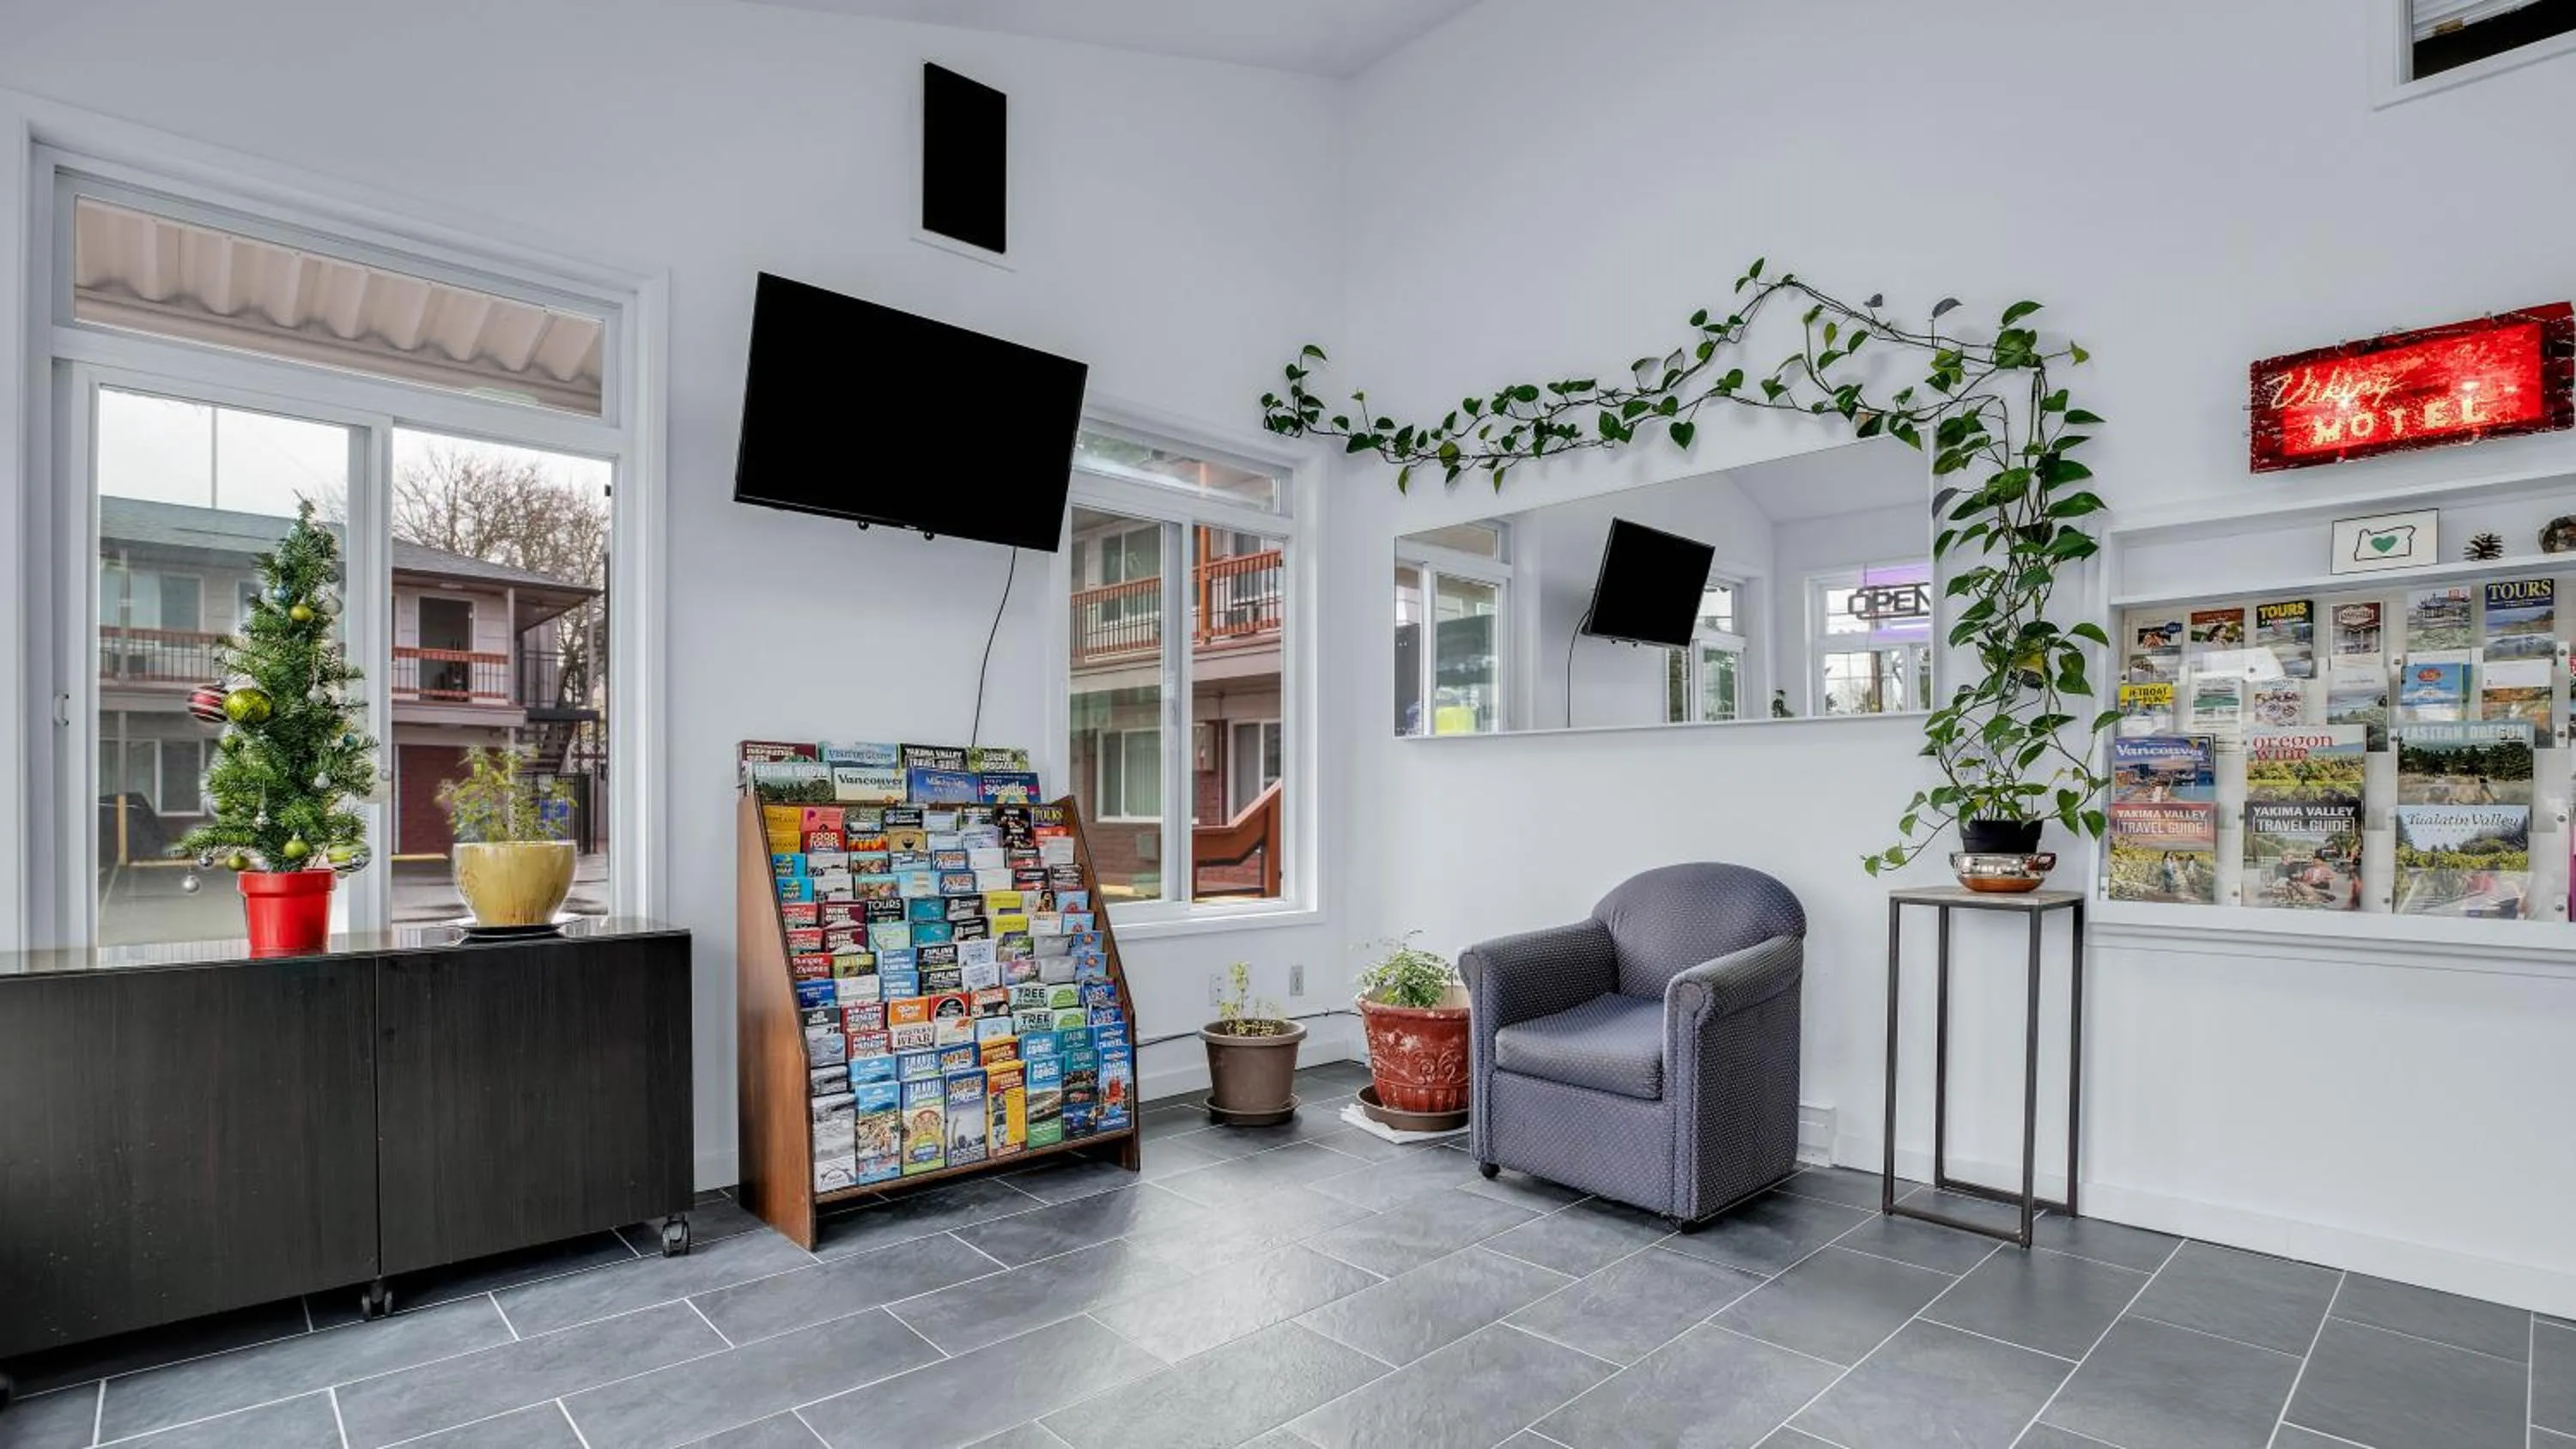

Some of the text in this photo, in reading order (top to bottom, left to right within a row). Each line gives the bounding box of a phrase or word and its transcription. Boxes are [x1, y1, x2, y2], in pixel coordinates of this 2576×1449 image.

[2267, 366, 2402, 410] Viking
[2312, 397, 2487, 445] MOTEL
[2488, 579, 2551, 600] TOURS
[2258, 602, 2306, 619] TOURS
[2403, 727, 2463, 740] EASTERN
[2252, 734, 2335, 751] oregon
[2117, 744, 2204, 756] Vancouver
[2255, 747, 2310, 761] wine
[837, 773, 903, 785] Vancouver
[984, 780, 1029, 796] seattle
[2117, 809, 2207, 821] YAKIMA VALLEY
[2253, 807, 2355, 816] YAKIMA VALLEY
[2257, 819, 2350, 832] TRAVEL GUIDE
[2408, 812, 2519, 827] Tualatin Valley
[2121, 821, 2203, 834] TRAVEL GUIDE
[810, 831, 838, 840] FOOD
[867, 900, 901, 911] TOURS
[1018, 988, 1045, 998] TREE
[1021, 1014, 1050, 1025] TREE
[897, 1034, 930, 1046] WEAR
